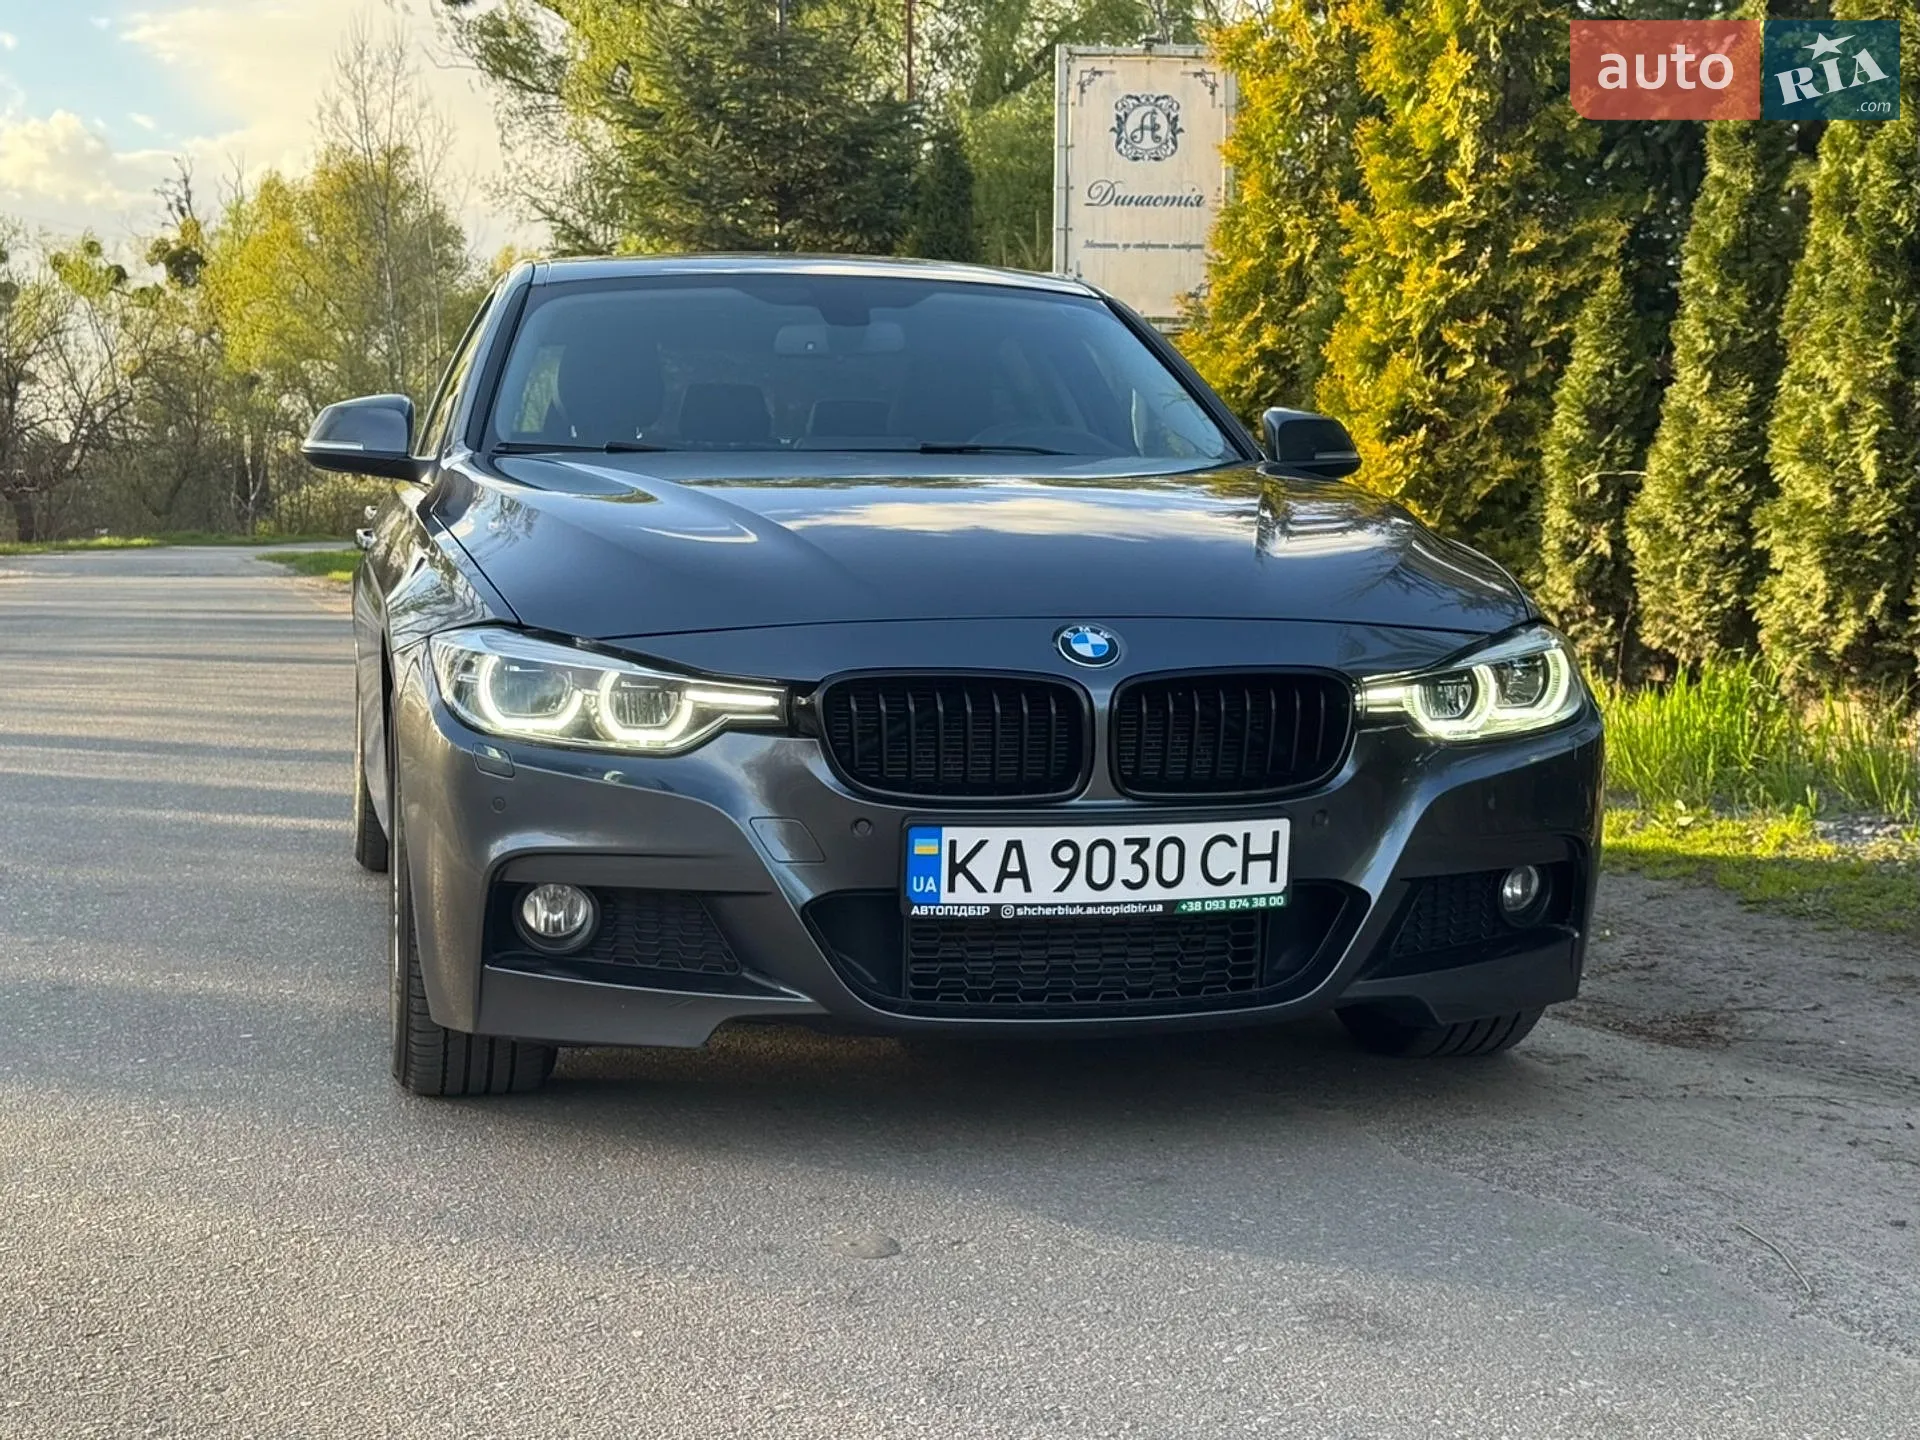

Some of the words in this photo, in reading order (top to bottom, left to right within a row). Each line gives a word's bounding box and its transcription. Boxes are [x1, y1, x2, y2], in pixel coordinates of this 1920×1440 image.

[1084, 179, 1205, 207] Династія
[946, 838, 1032, 893] KA
[1050, 835, 1186, 893] 9030
[1199, 830, 1281, 887] CH
[912, 876, 937, 893] UA
[911, 905, 991, 917] АВТОПІДБІР
[1180, 901, 1201, 912] +38
[1204, 900, 1226, 911] 093
[1251, 897, 1266, 907] 38
[1269, 895, 1284, 906] 00
